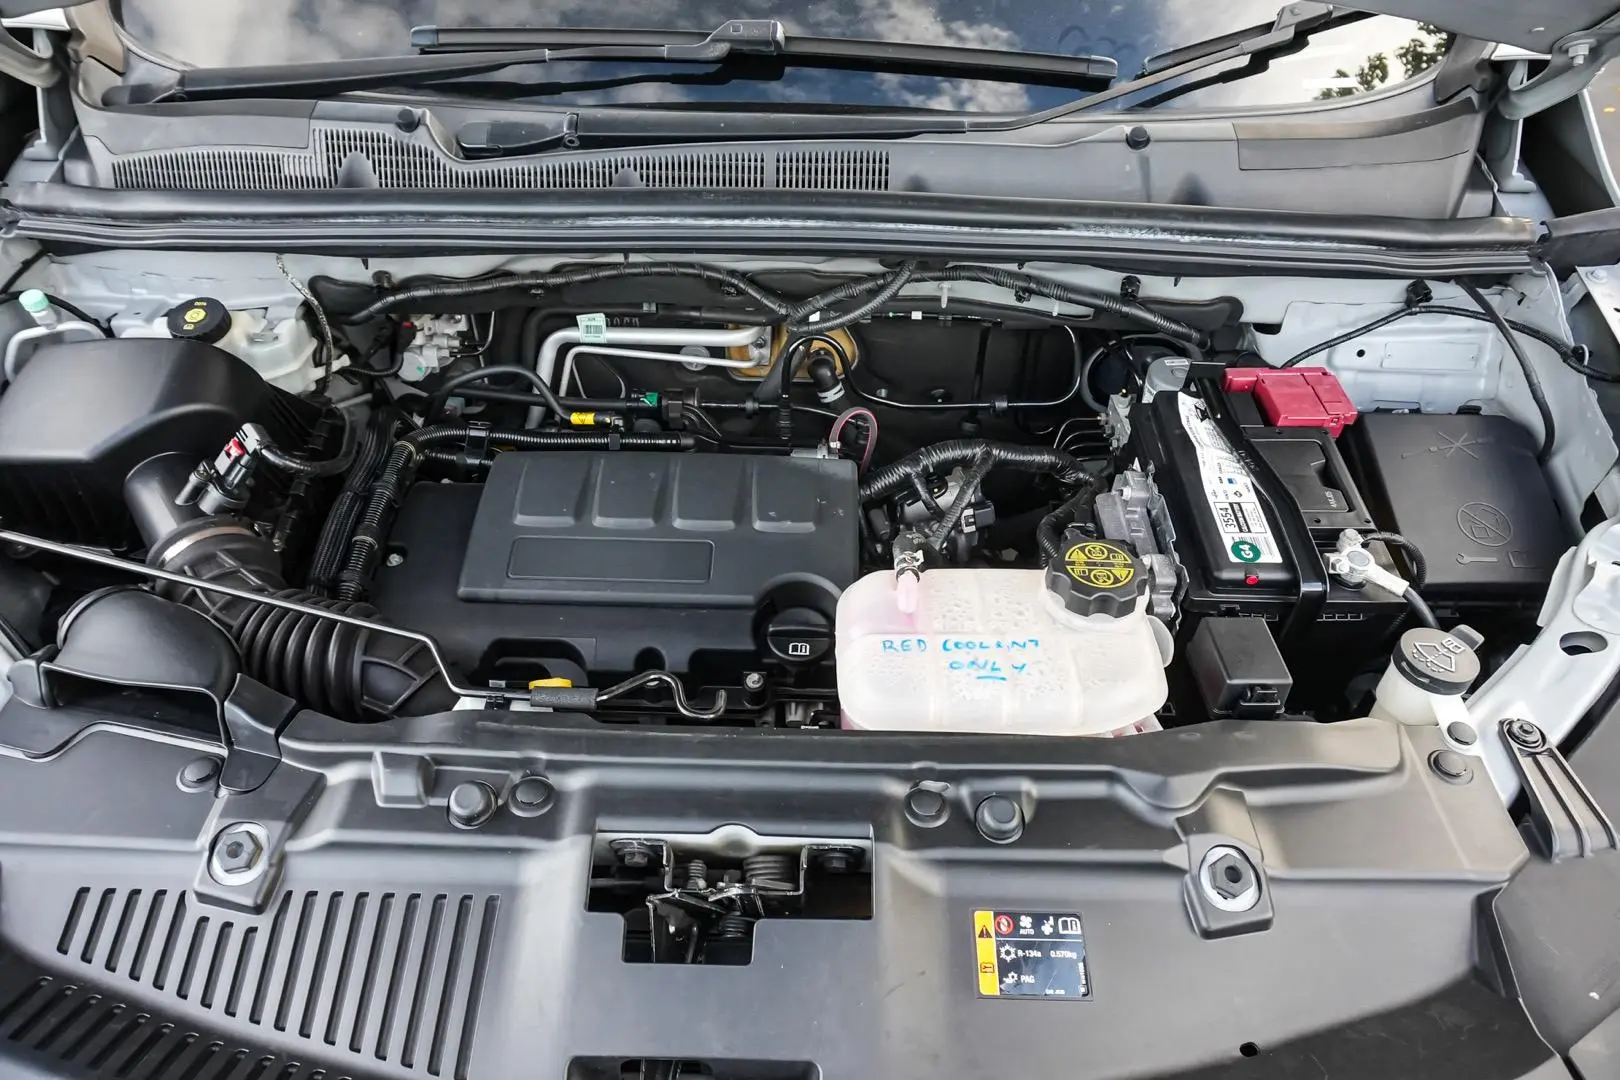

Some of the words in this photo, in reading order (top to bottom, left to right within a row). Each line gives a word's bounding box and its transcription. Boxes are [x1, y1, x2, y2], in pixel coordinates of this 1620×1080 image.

[1218, 507, 1236, 528] 3554
[882, 638, 928, 653] RED
[949, 660, 1027, 673] ONLY
[1017, 949, 1042, 958] R-134a
[1050, 950, 1078, 960] 0.570kg
[1020, 975, 1035, 984] PAG
